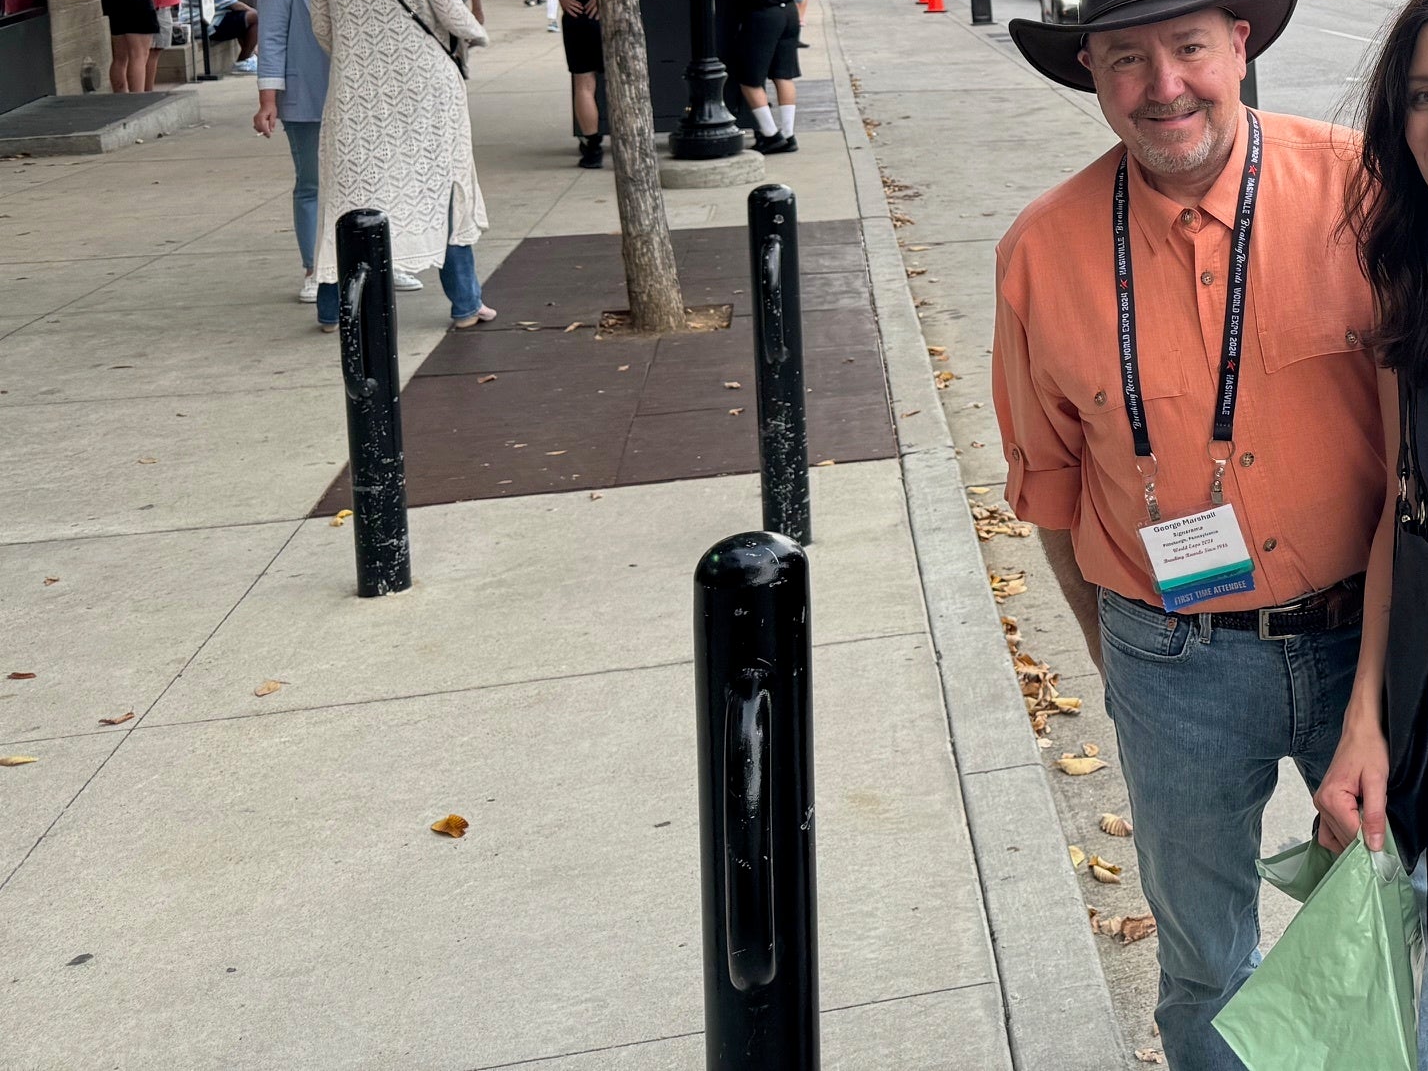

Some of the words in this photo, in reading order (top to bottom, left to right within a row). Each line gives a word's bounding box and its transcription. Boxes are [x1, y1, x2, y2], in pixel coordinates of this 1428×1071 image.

[1121, 292, 1130, 312] 2024
[1232, 287, 1242, 313] WORLD
[1122, 313, 1130, 333] EXPO
[1230, 315, 1240, 335] EXPO
[1123, 334, 1132, 361] WORLD
[1228, 337, 1237, 357] 2024
[1222, 374, 1235, 416] NASHVILLE
[1153, 521, 1182, 533] George
[1182, 511, 1216, 527] Marshall
[1174, 593, 1195, 606] FIRST
[1195, 588, 1214, 600] TIME
[1213, 580, 1247, 595] ATTENDEE
